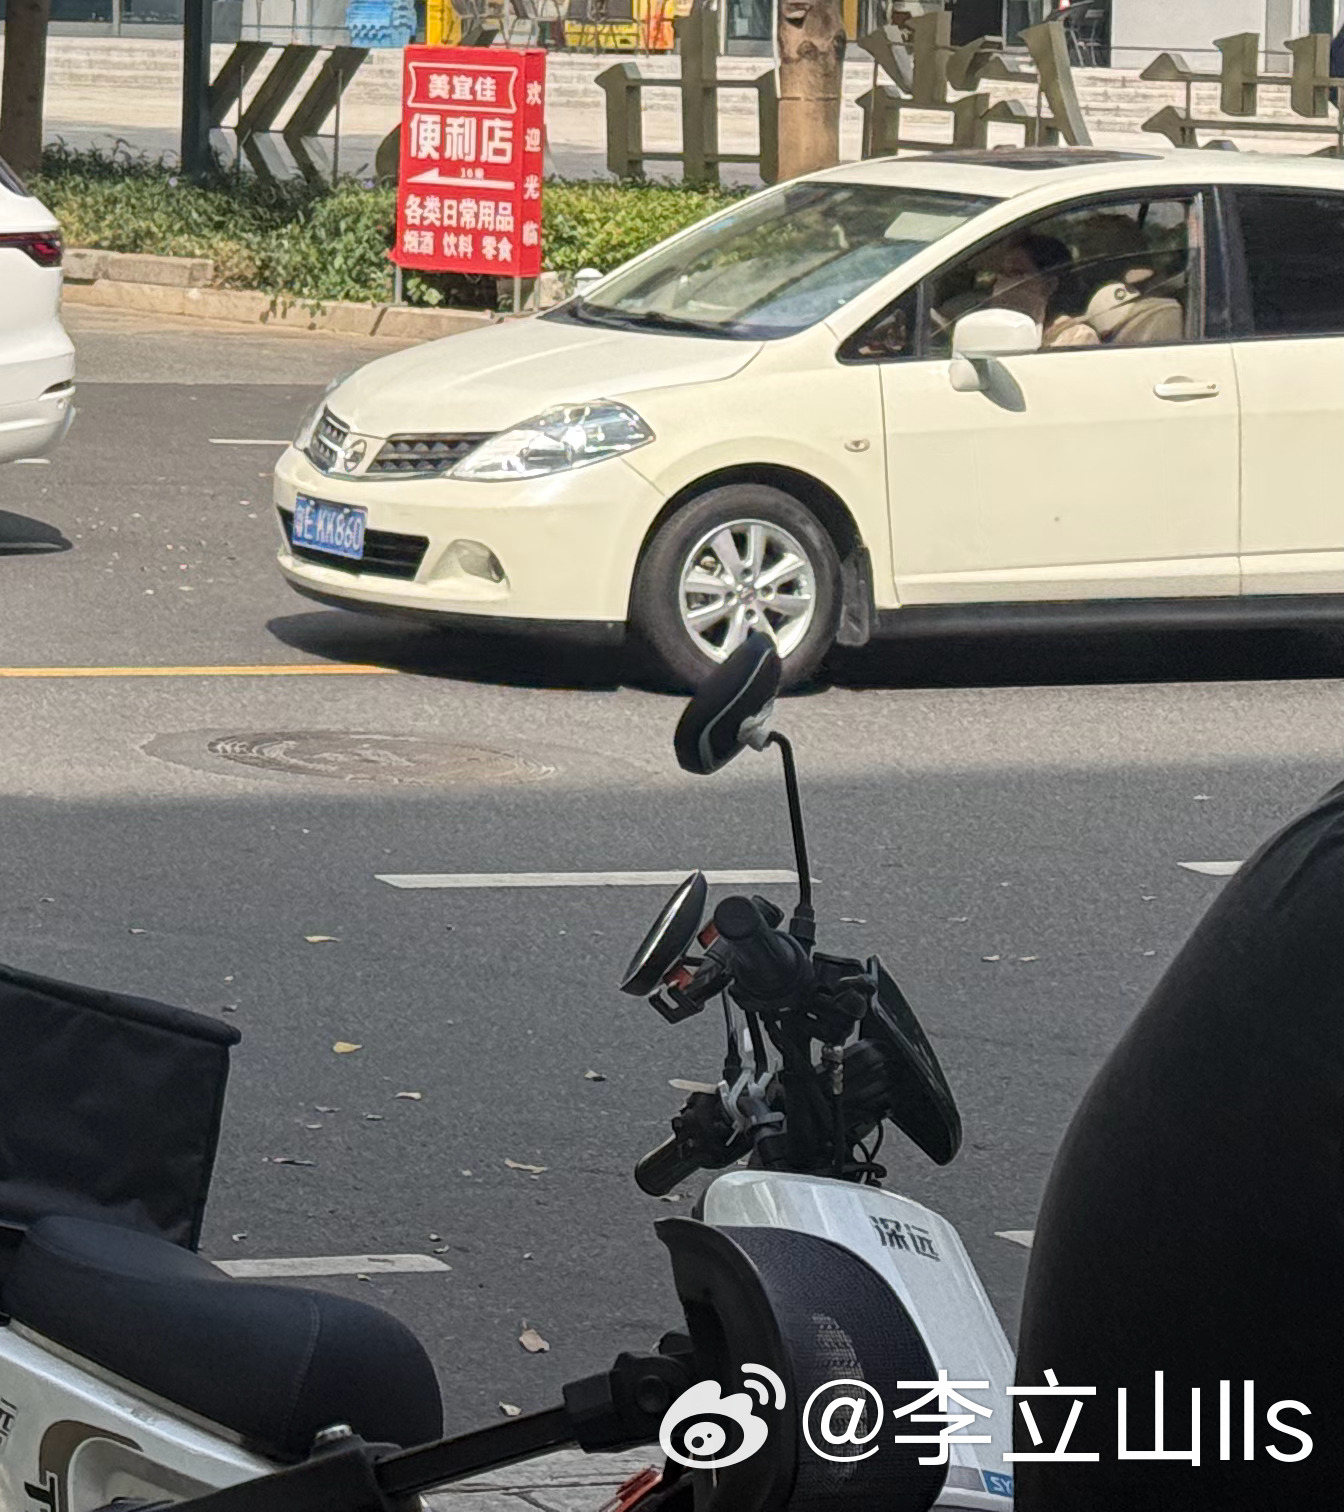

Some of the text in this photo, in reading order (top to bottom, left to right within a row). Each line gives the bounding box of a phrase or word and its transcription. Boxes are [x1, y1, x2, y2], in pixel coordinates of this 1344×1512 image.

[428, 73, 497, 103] 美宜佳
[410, 113, 513, 164] 便利店
[522, 80, 542, 248] 欢迎光临
[404, 194, 514, 232] 各类日常用品
[402, 231, 513, 262] 烟酒 饮料 零食
[869, 1214, 942, 1263] 深远
